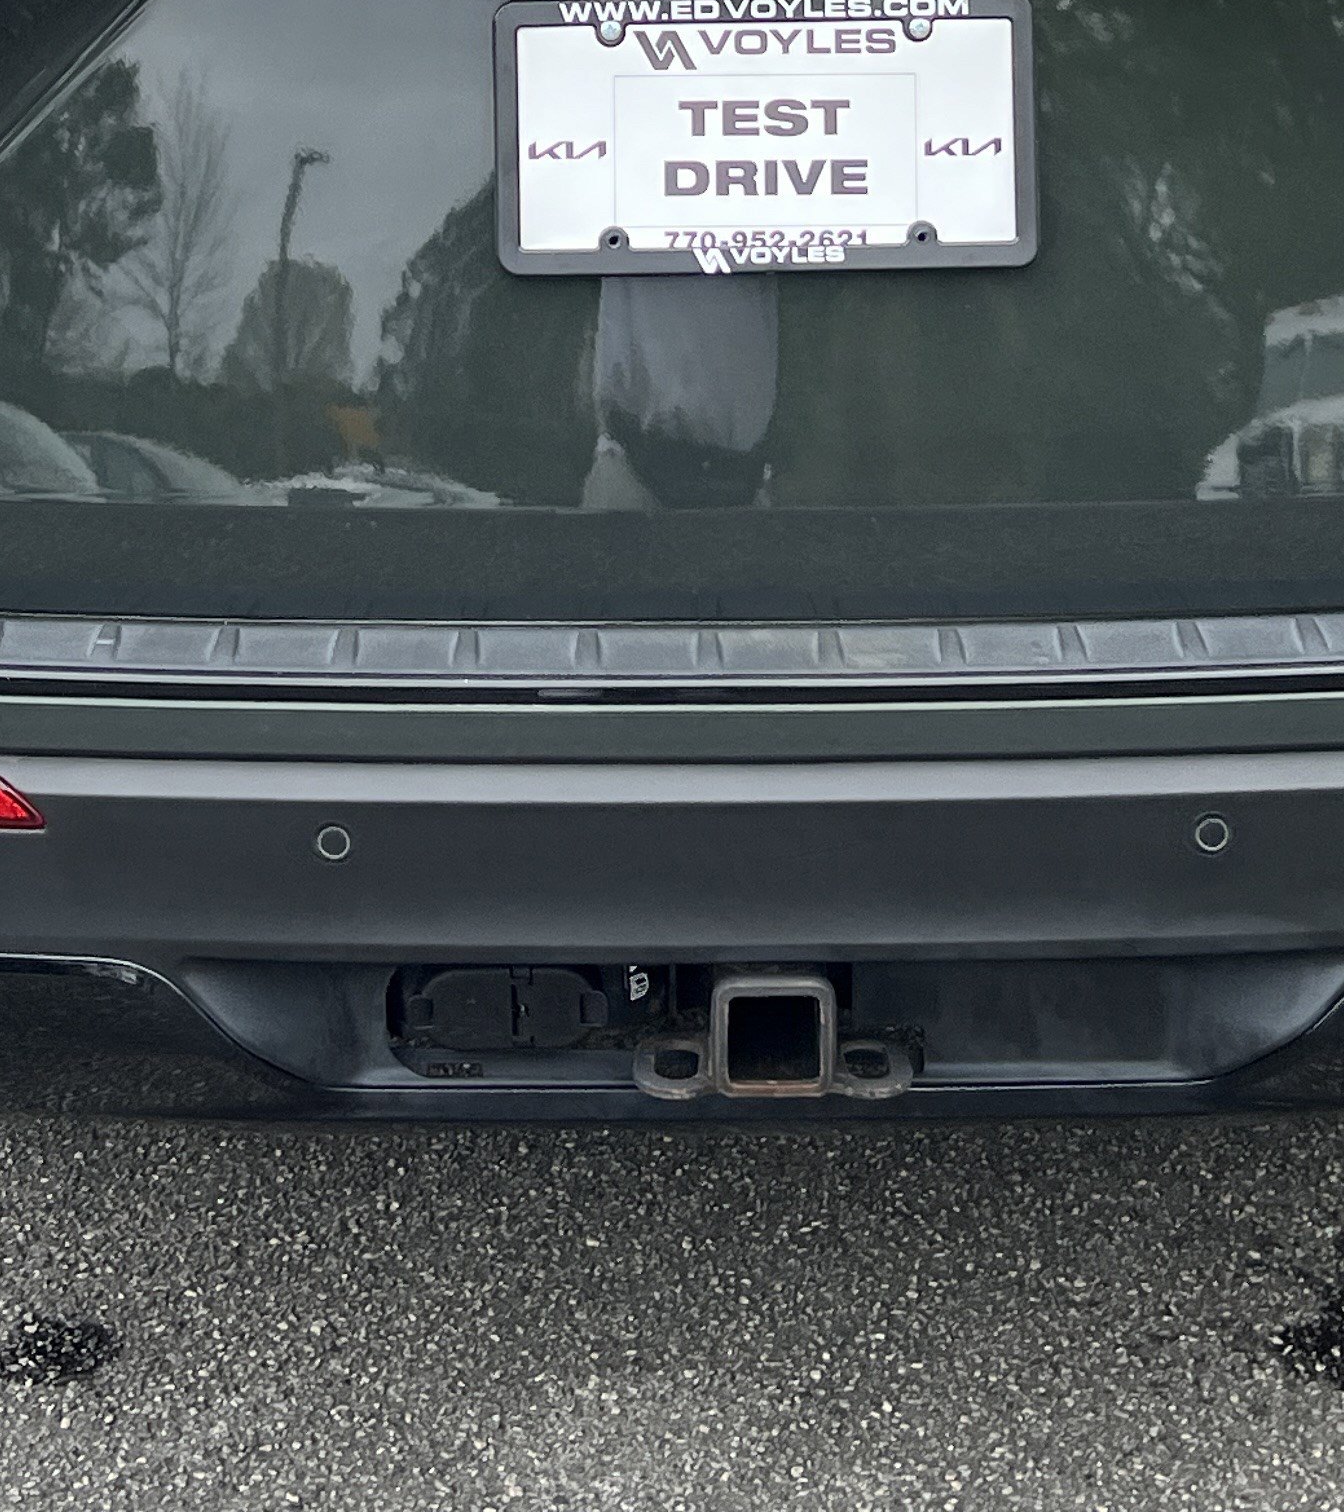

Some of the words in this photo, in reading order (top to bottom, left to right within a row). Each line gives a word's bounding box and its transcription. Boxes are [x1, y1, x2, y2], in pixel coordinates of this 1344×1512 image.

[697, 27, 898, 55] VOYLES
[677, 98, 852, 138] TEST
[663, 158, 869, 197] DRIVE
[729, 245, 846, 265] VOYLES
